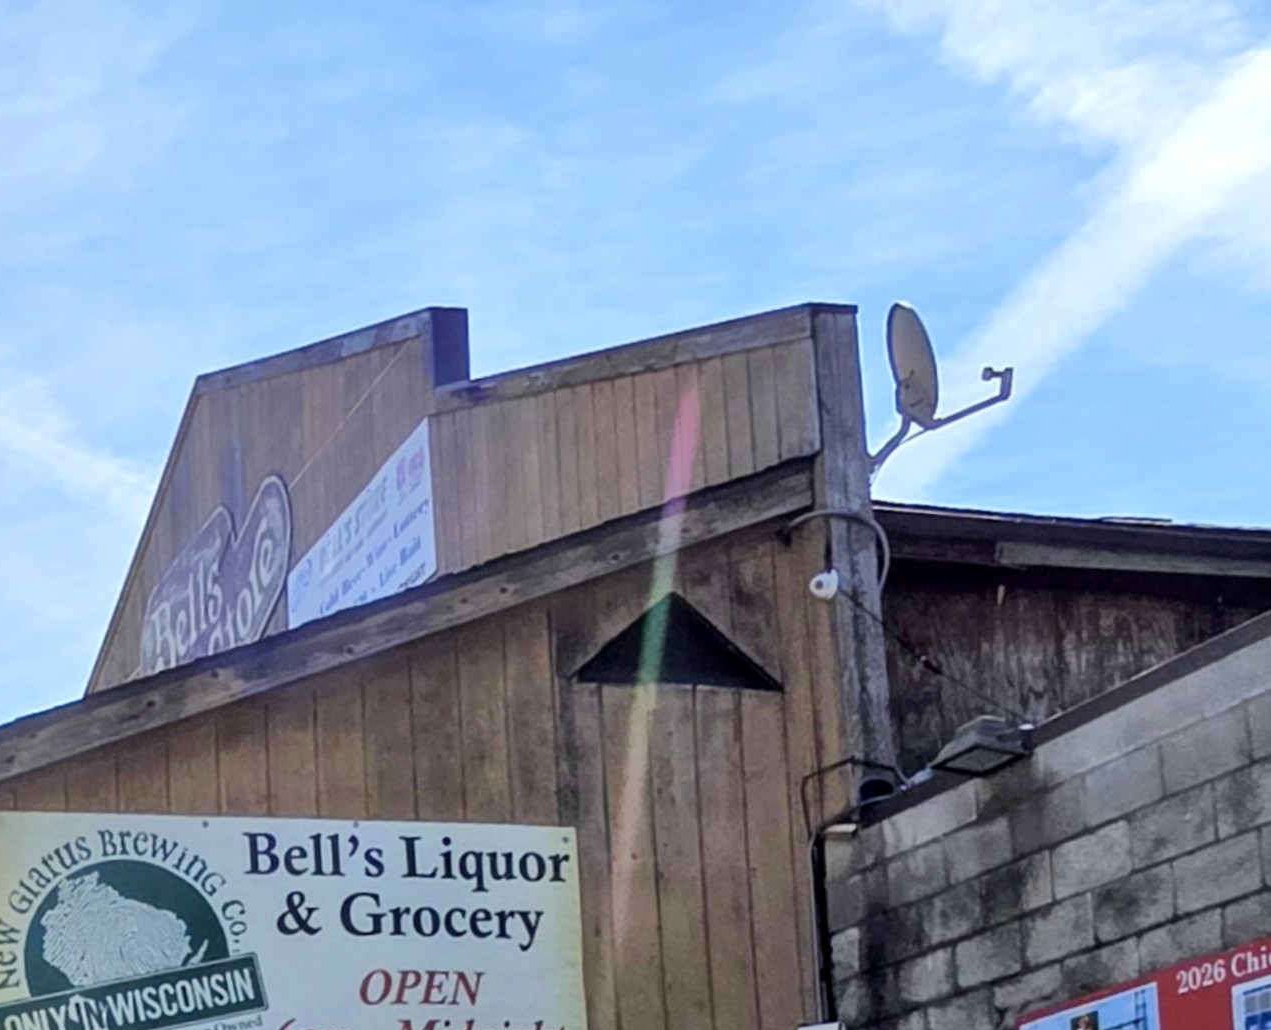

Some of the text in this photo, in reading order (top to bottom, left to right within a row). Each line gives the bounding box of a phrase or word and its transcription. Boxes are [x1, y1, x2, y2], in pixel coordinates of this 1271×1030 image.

[8, 836, 91, 914] Glarus
[242, 832, 569, 892] Bell's Liquor
[277, 891, 544, 951] & Grocery
[106, 968, 254, 1026] WISCONSIN
[359, 969, 485, 1006] OPEN
[1176, 959, 1227, 995] 2026
